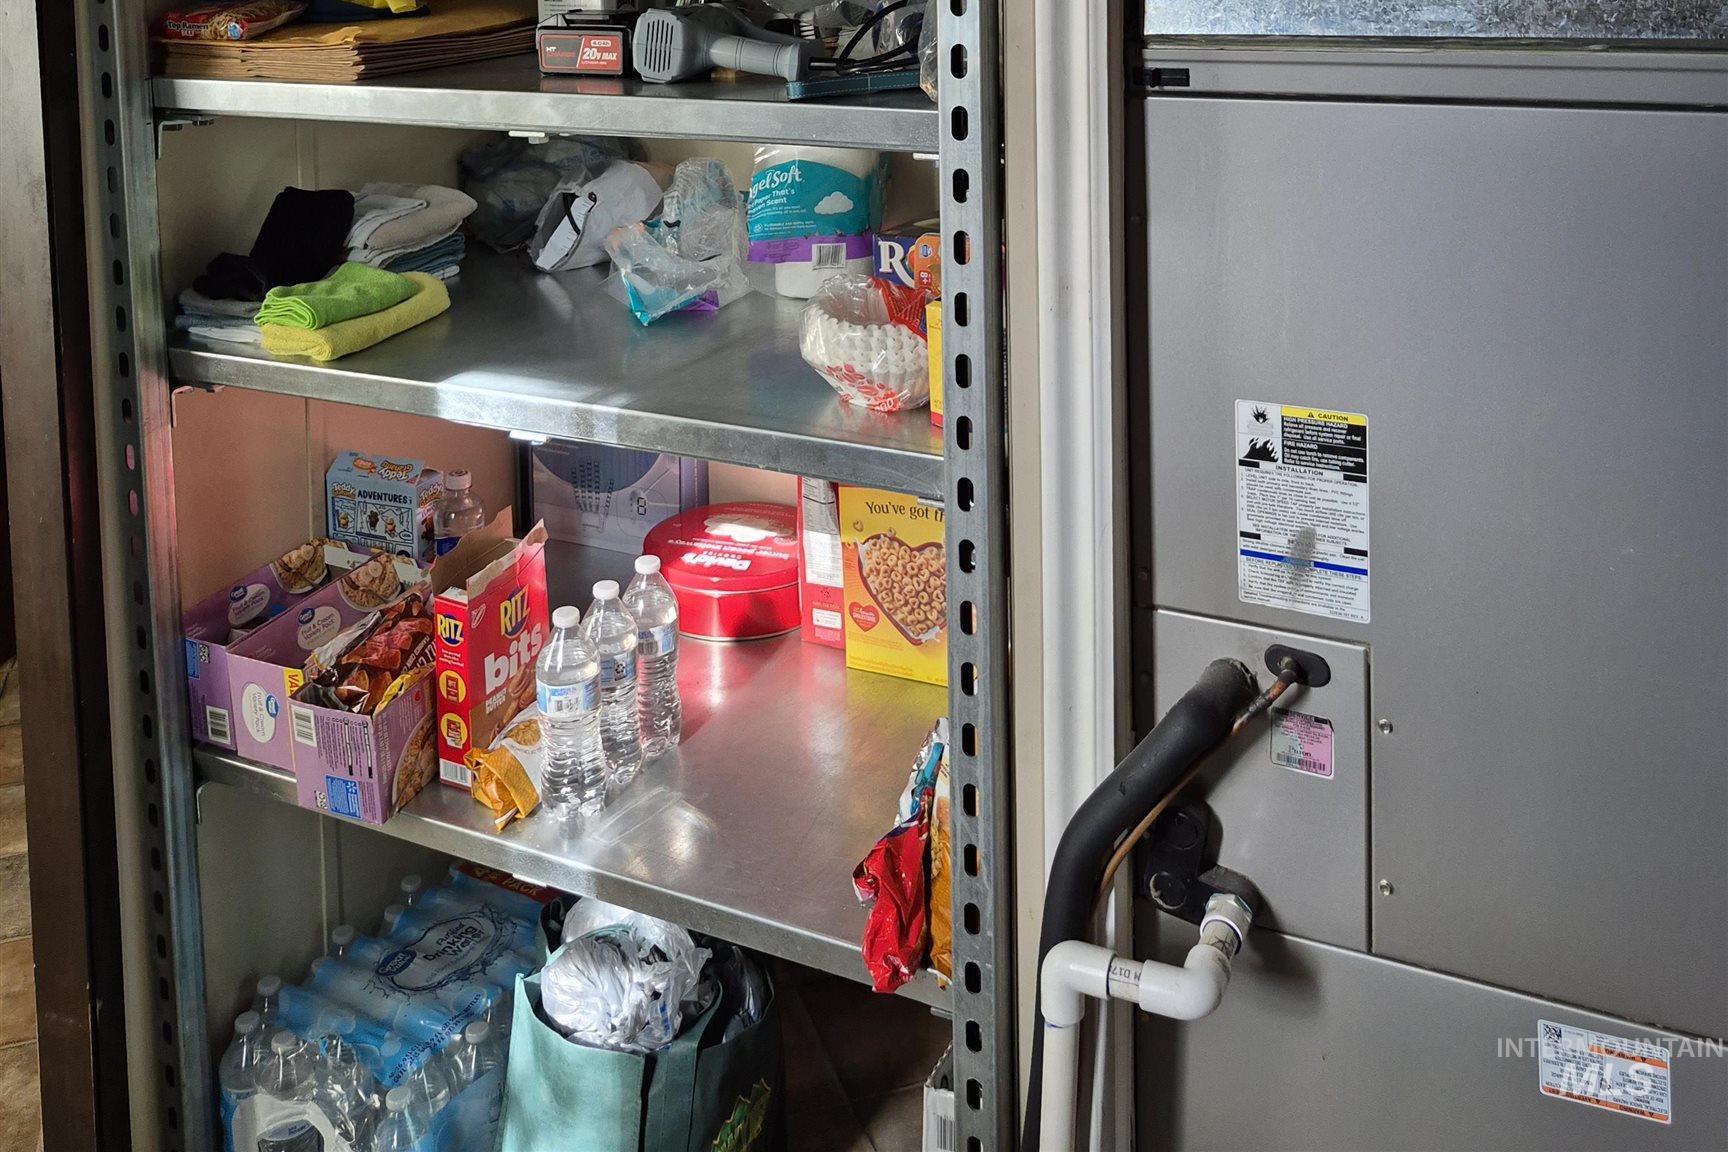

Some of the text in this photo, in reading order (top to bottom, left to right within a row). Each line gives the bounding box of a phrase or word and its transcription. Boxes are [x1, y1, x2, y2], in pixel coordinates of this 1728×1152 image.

[167, 20, 209, 31] Top Ramen
[601, 52, 618, 61] MAX
[772, 188, 796, 198] That's
[766, 197, 787, 206] Scent
[1317, 413, 1349, 422] CAUTION
[1325, 421, 1349, 429] HAZARD
[1295, 441, 1318, 450] HAZARD
[1276, 465, 1324, 476] INSTALLATION
[357, 489, 408, 504] ADVENTURES
[866, 501, 929, 520] You've got
[500, 584, 531, 636] RITZ
[436, 613, 464, 643] RITZ
[483, 623, 542, 695] bits
[436, 922, 466, 946] Purified
[423, 925, 478, 961] Drinking
[449, 930, 485, 958] Water
